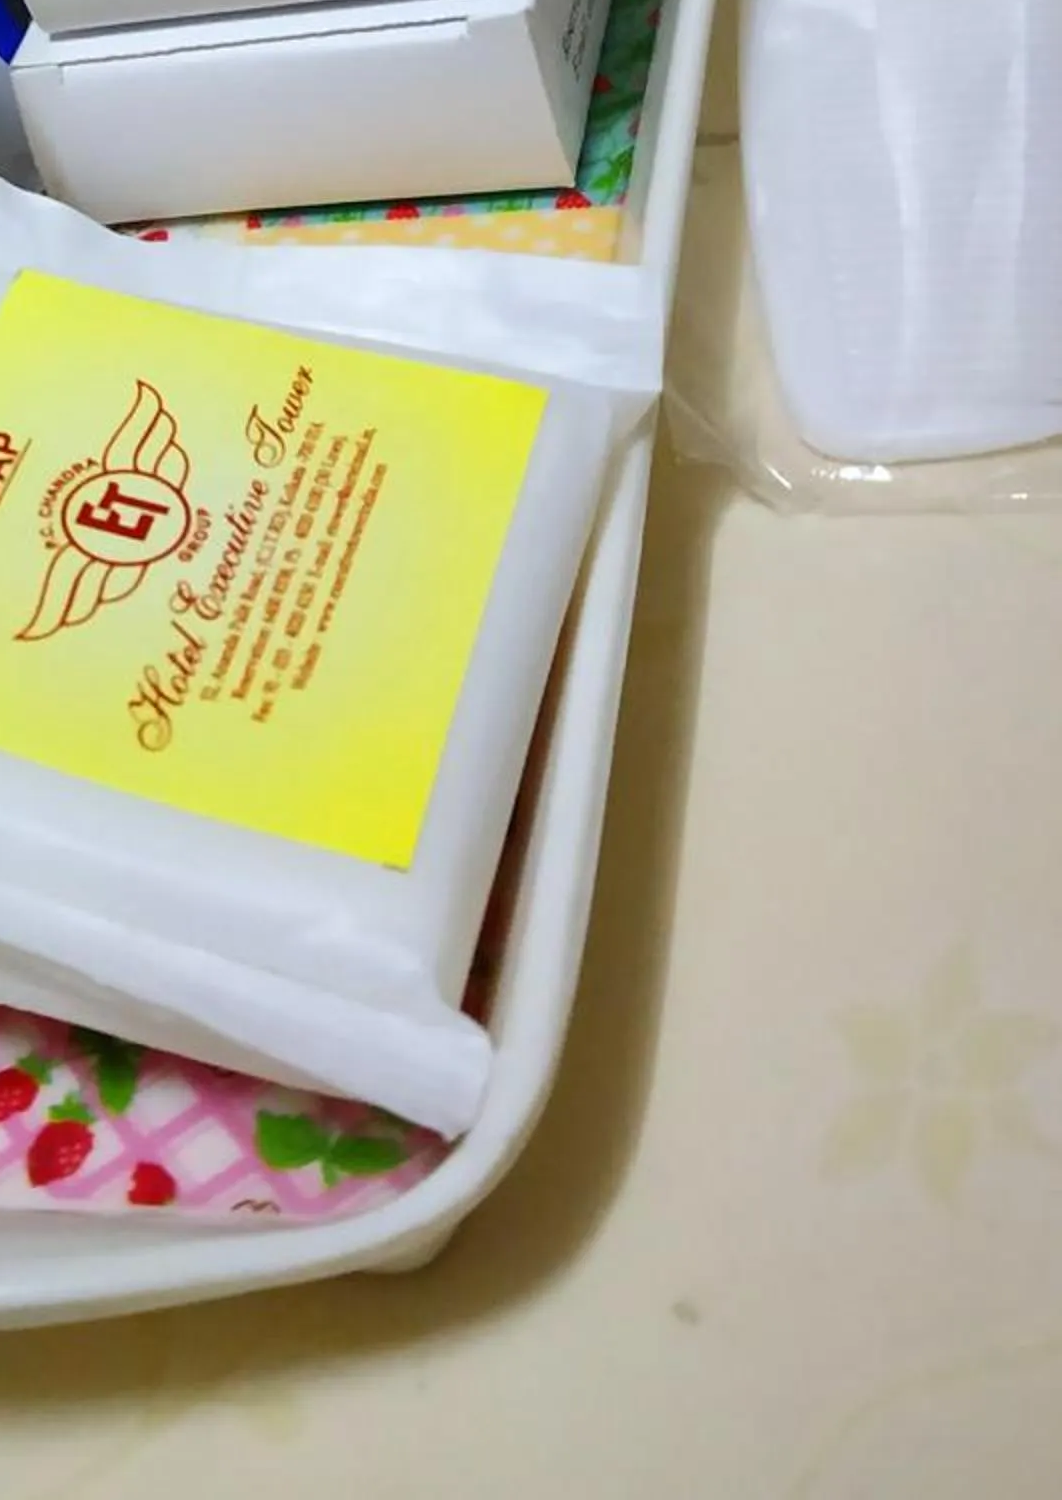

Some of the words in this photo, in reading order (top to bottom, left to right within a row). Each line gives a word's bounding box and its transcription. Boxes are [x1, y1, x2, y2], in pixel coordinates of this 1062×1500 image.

[39, 457, 99, 518] CHANDRA
[75, 481, 171, 542] ET
[128, 620, 207, 753] Hotel
[169, 479, 271, 621] Executive
[246, 365, 314, 469] Tower
[177, 508, 213, 563] GROUP
